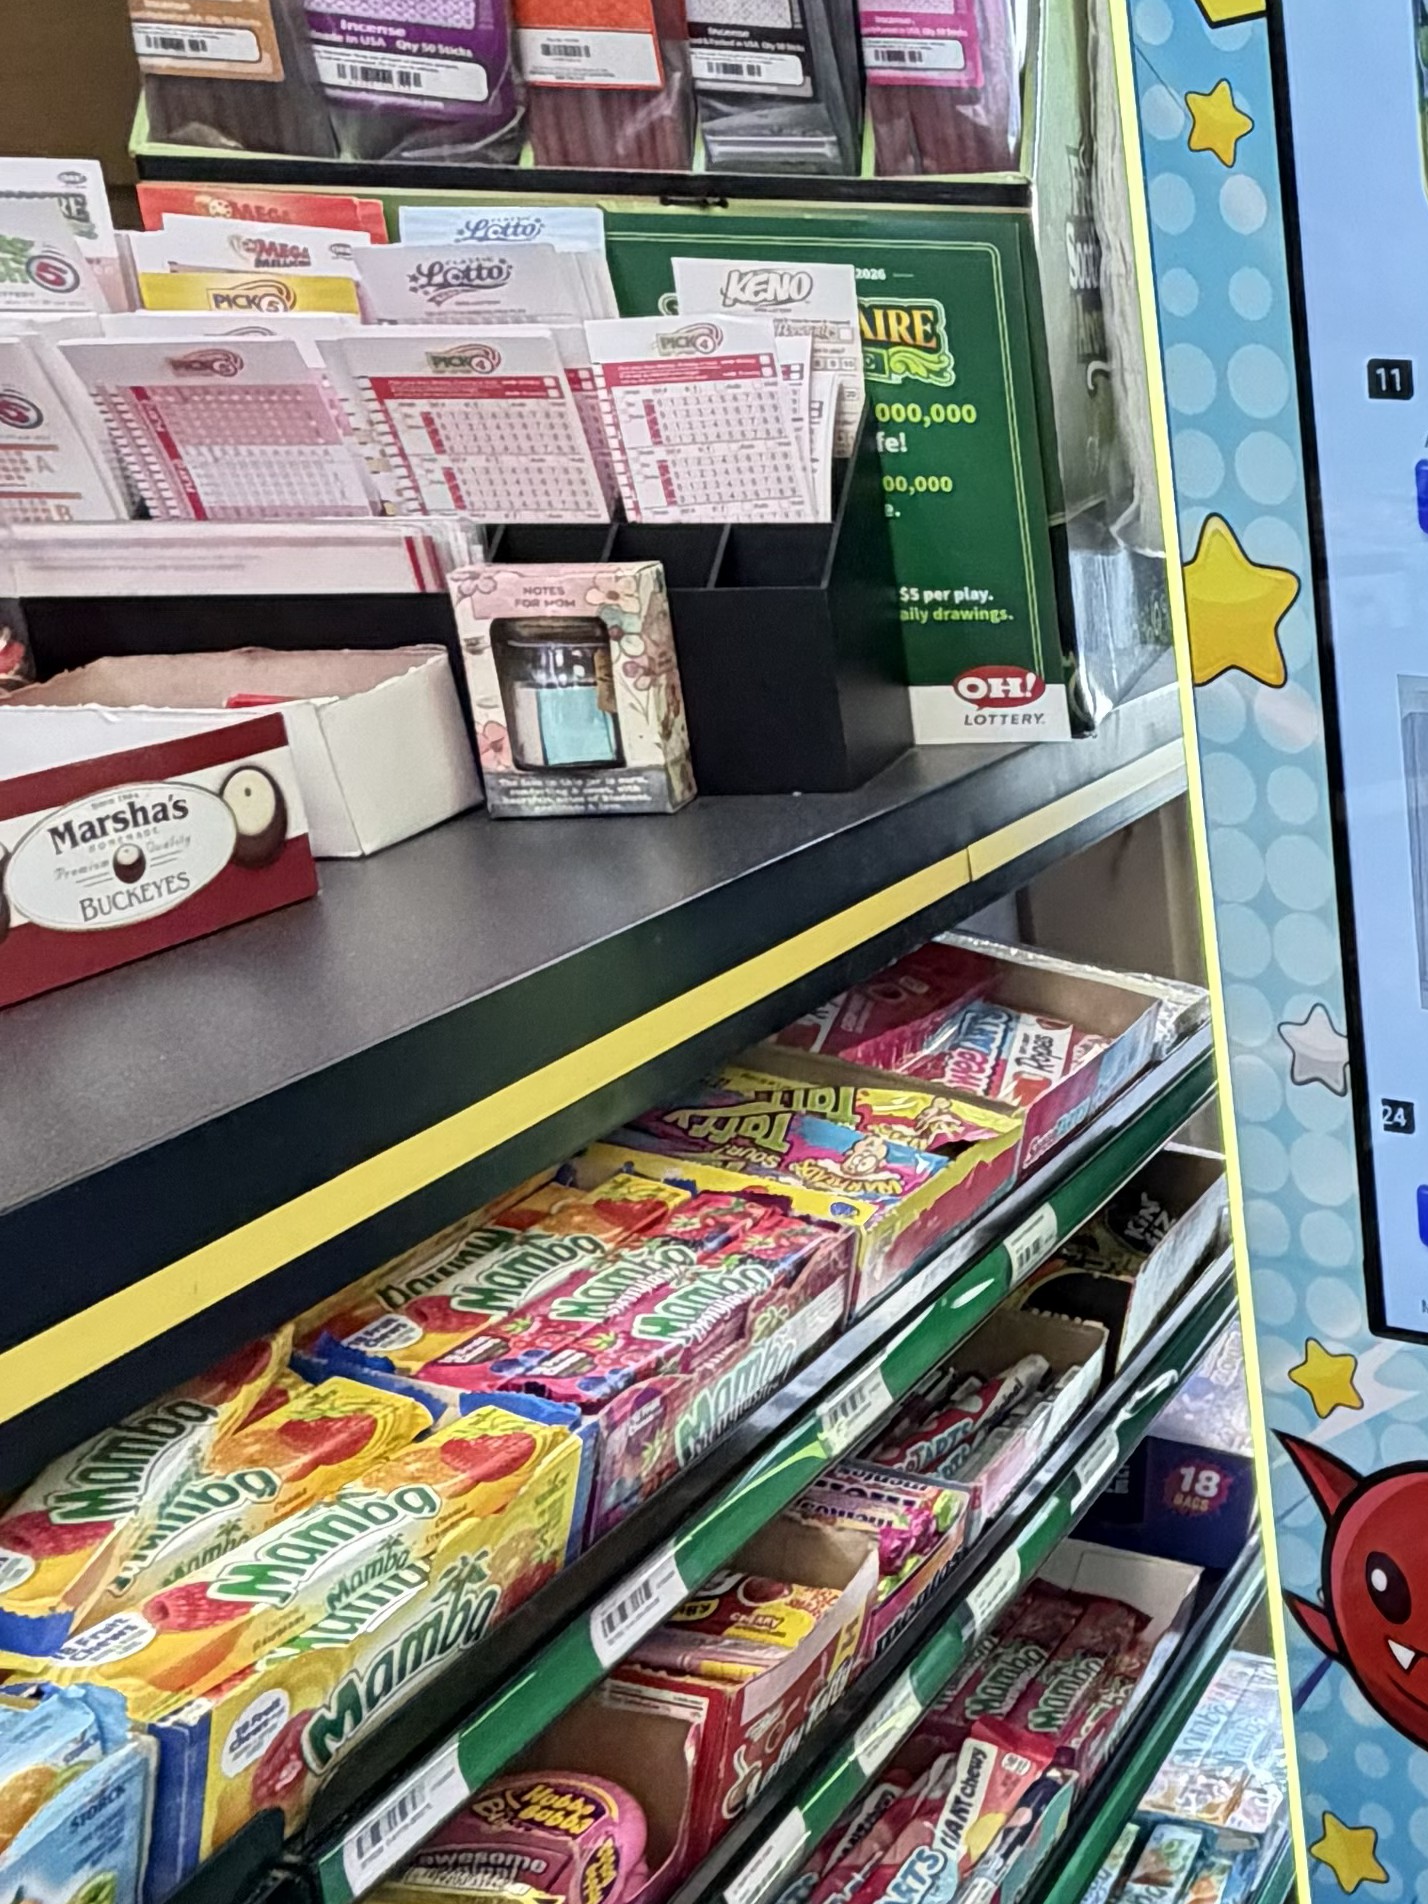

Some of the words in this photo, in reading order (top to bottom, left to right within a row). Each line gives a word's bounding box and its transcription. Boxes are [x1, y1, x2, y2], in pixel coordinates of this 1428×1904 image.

[340, 19, 406, 38] Incense
[212, 294, 260, 312] PICK
[722, 269, 814, 307] KENO
[1375, 366, 1402, 392] 11
[523, 586, 565, 596] NOTES
[899, 587, 920, 603] $5
[924, 589, 949, 606] per
[953, 587, 993, 606] play.
[933, 606, 1013, 624] drawings.
[956, 673, 1037, 701] OH!
[964, 712, 1044, 727] LOTTERY
[48, 794, 189, 856] Marsha's
[80, 872, 190, 922] BUCKEYES
[451, 1231, 607, 1318] Mamba
[549, 1244, 697, 1323] Mamba
[631, 1264, 774, 1341] Mamba
[48, 1397, 217, 1524] Mamba
[207, 1477, 443, 1608] Mamba
[300, 1579, 501, 1775] Mamba
[522, 1783, 596, 1814] Hubba
[518, 1804, 596, 1834] Bubba
